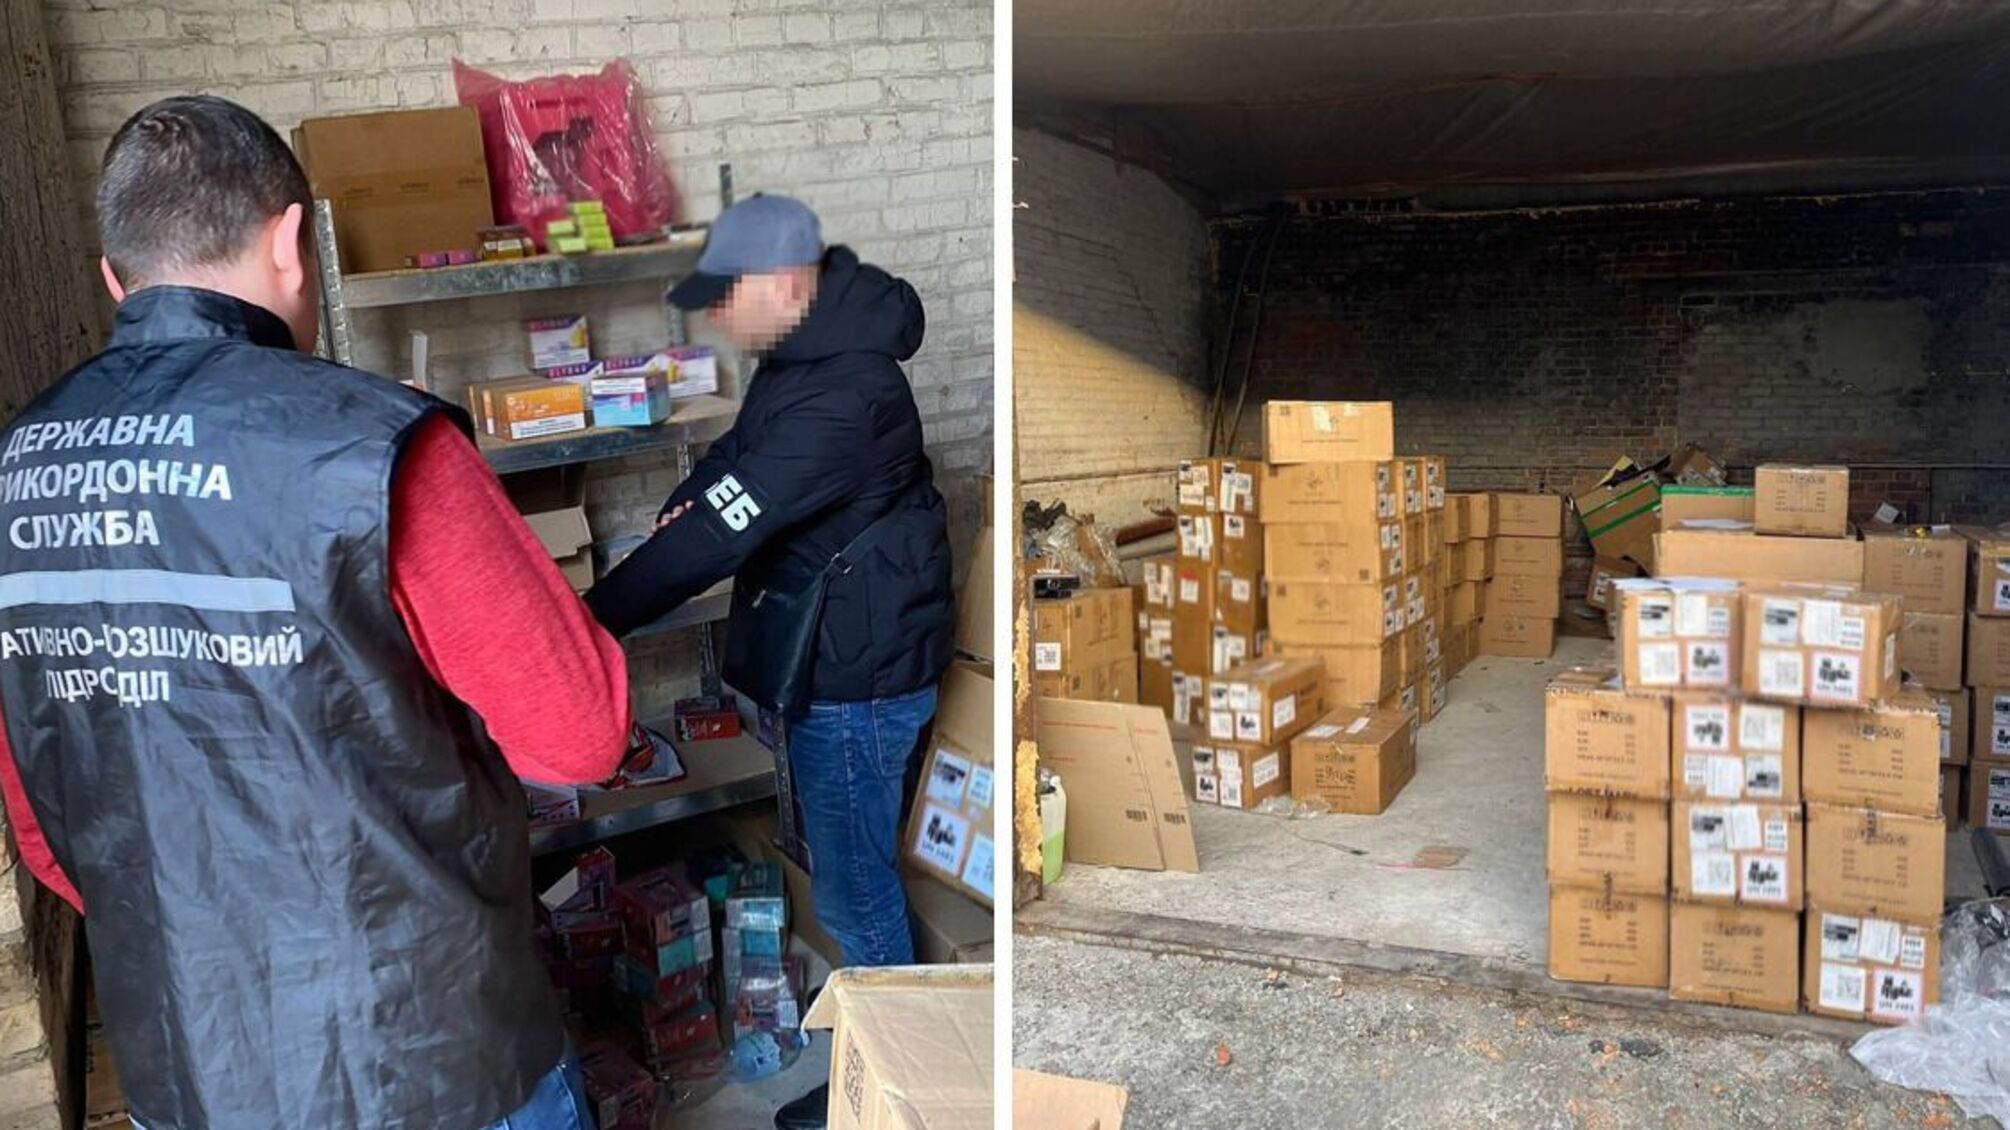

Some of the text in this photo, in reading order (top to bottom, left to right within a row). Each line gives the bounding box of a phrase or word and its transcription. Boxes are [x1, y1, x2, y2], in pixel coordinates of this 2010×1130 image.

[2, 414, 195, 466] ДЕРЖАВНА
[704, 473, 762, 531] ЕБ
[9, 510, 160, 550] СЛУЖБА
[1, 625, 304, 667] АТИВНО-ОЗШУКОВИЙ
